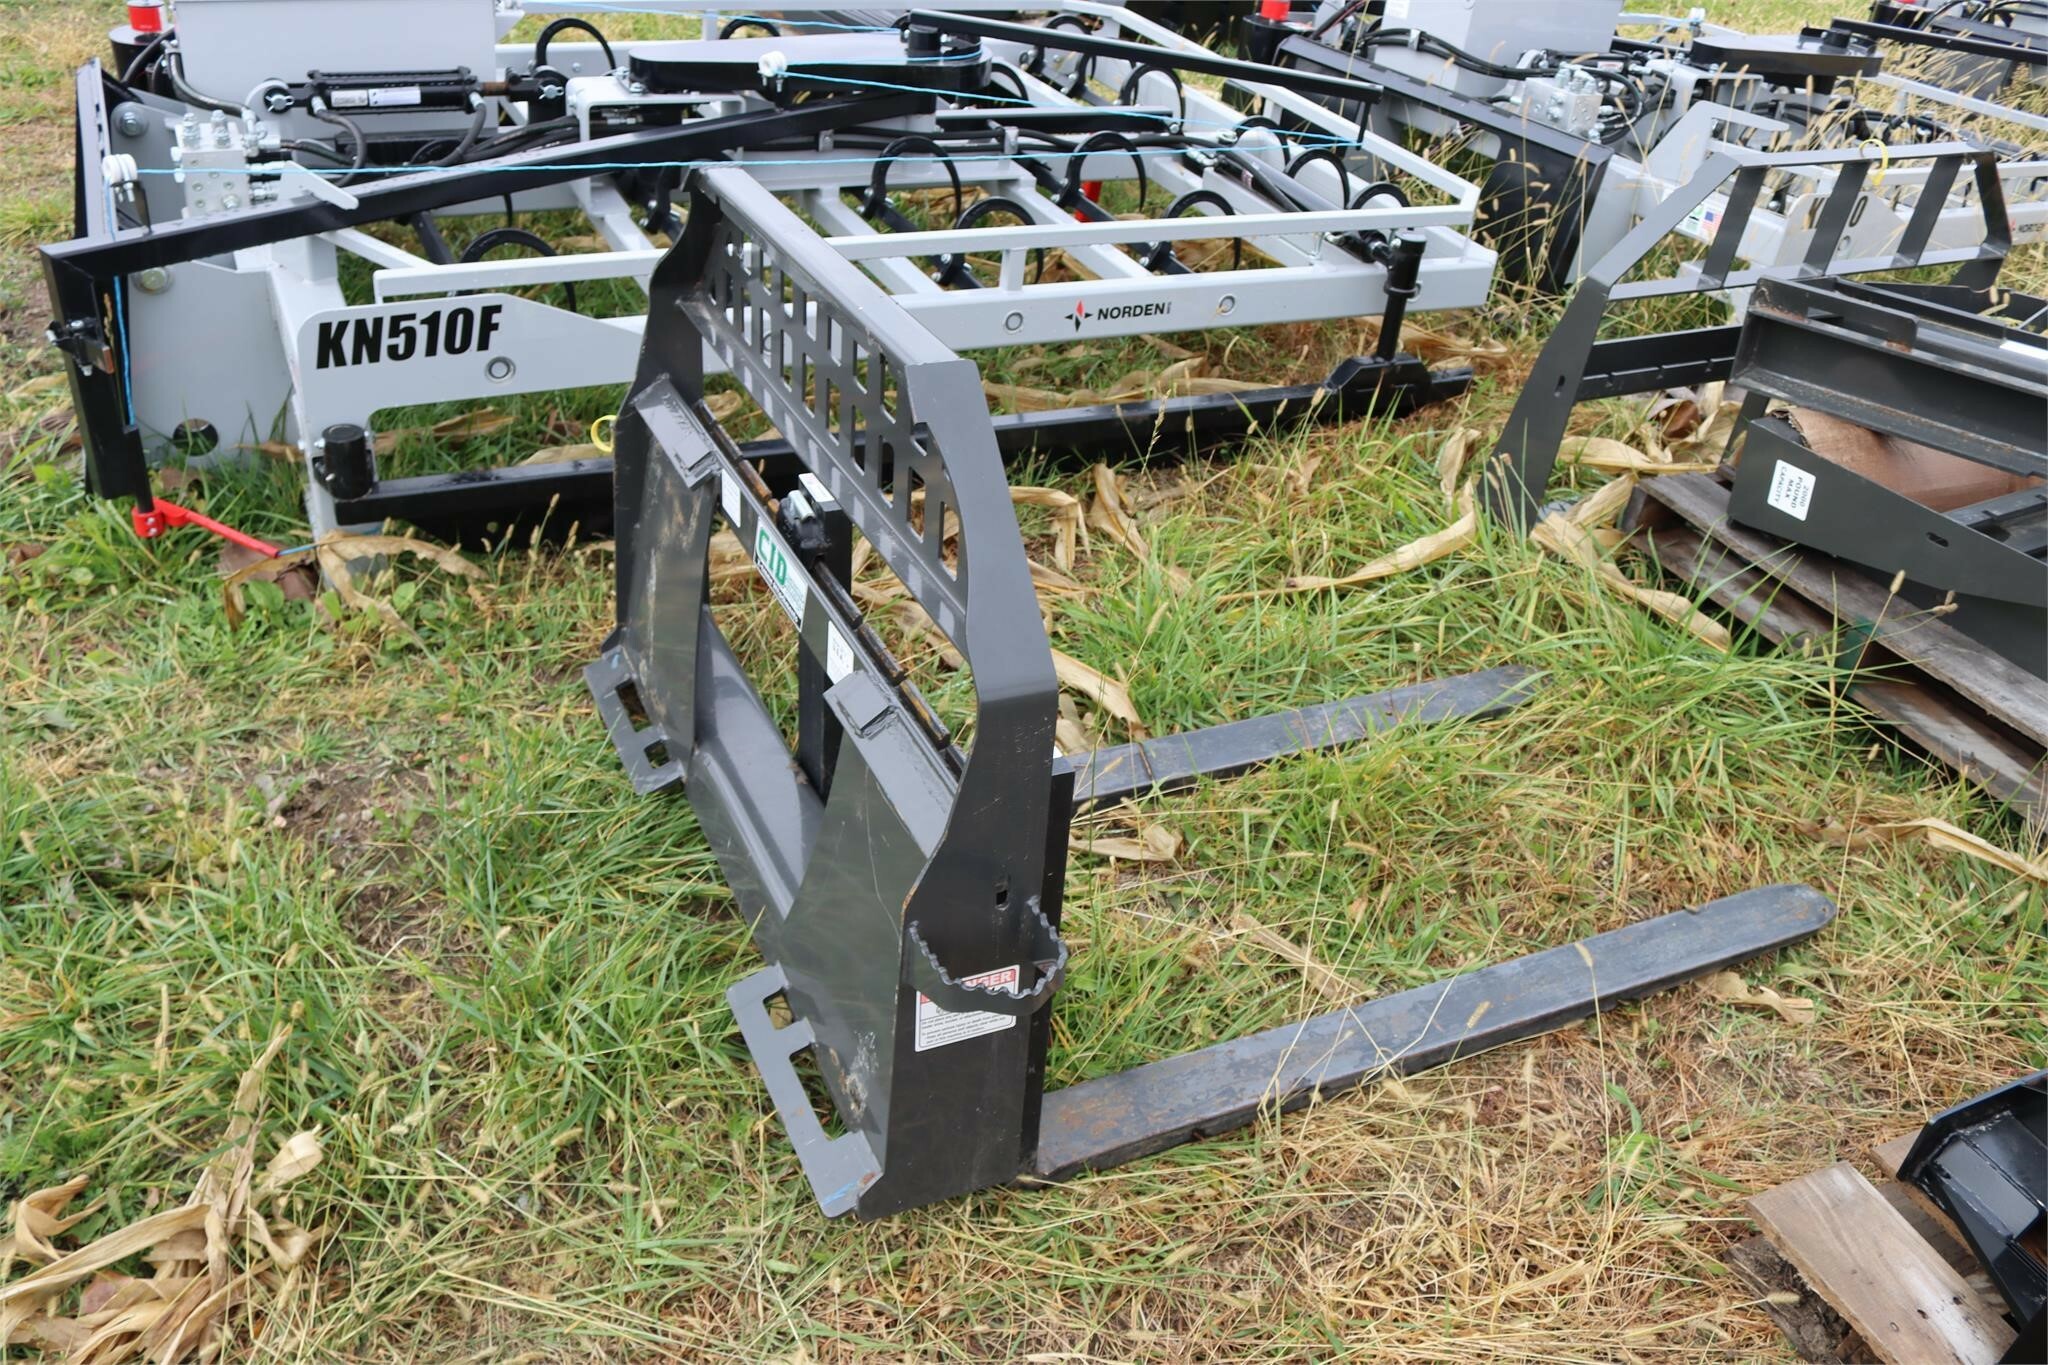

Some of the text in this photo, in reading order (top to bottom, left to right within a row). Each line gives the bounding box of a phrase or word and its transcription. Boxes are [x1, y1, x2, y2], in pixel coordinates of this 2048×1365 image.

[1098, 303, 1166, 320] NORDEN
[316, 304, 502, 369] KN510F
[1774, 467, 1787, 502] CAPACITY
[1785, 480, 1794, 498] MAX
[1791, 477, 1803, 508] POUND
[758, 528, 787, 585] CID
